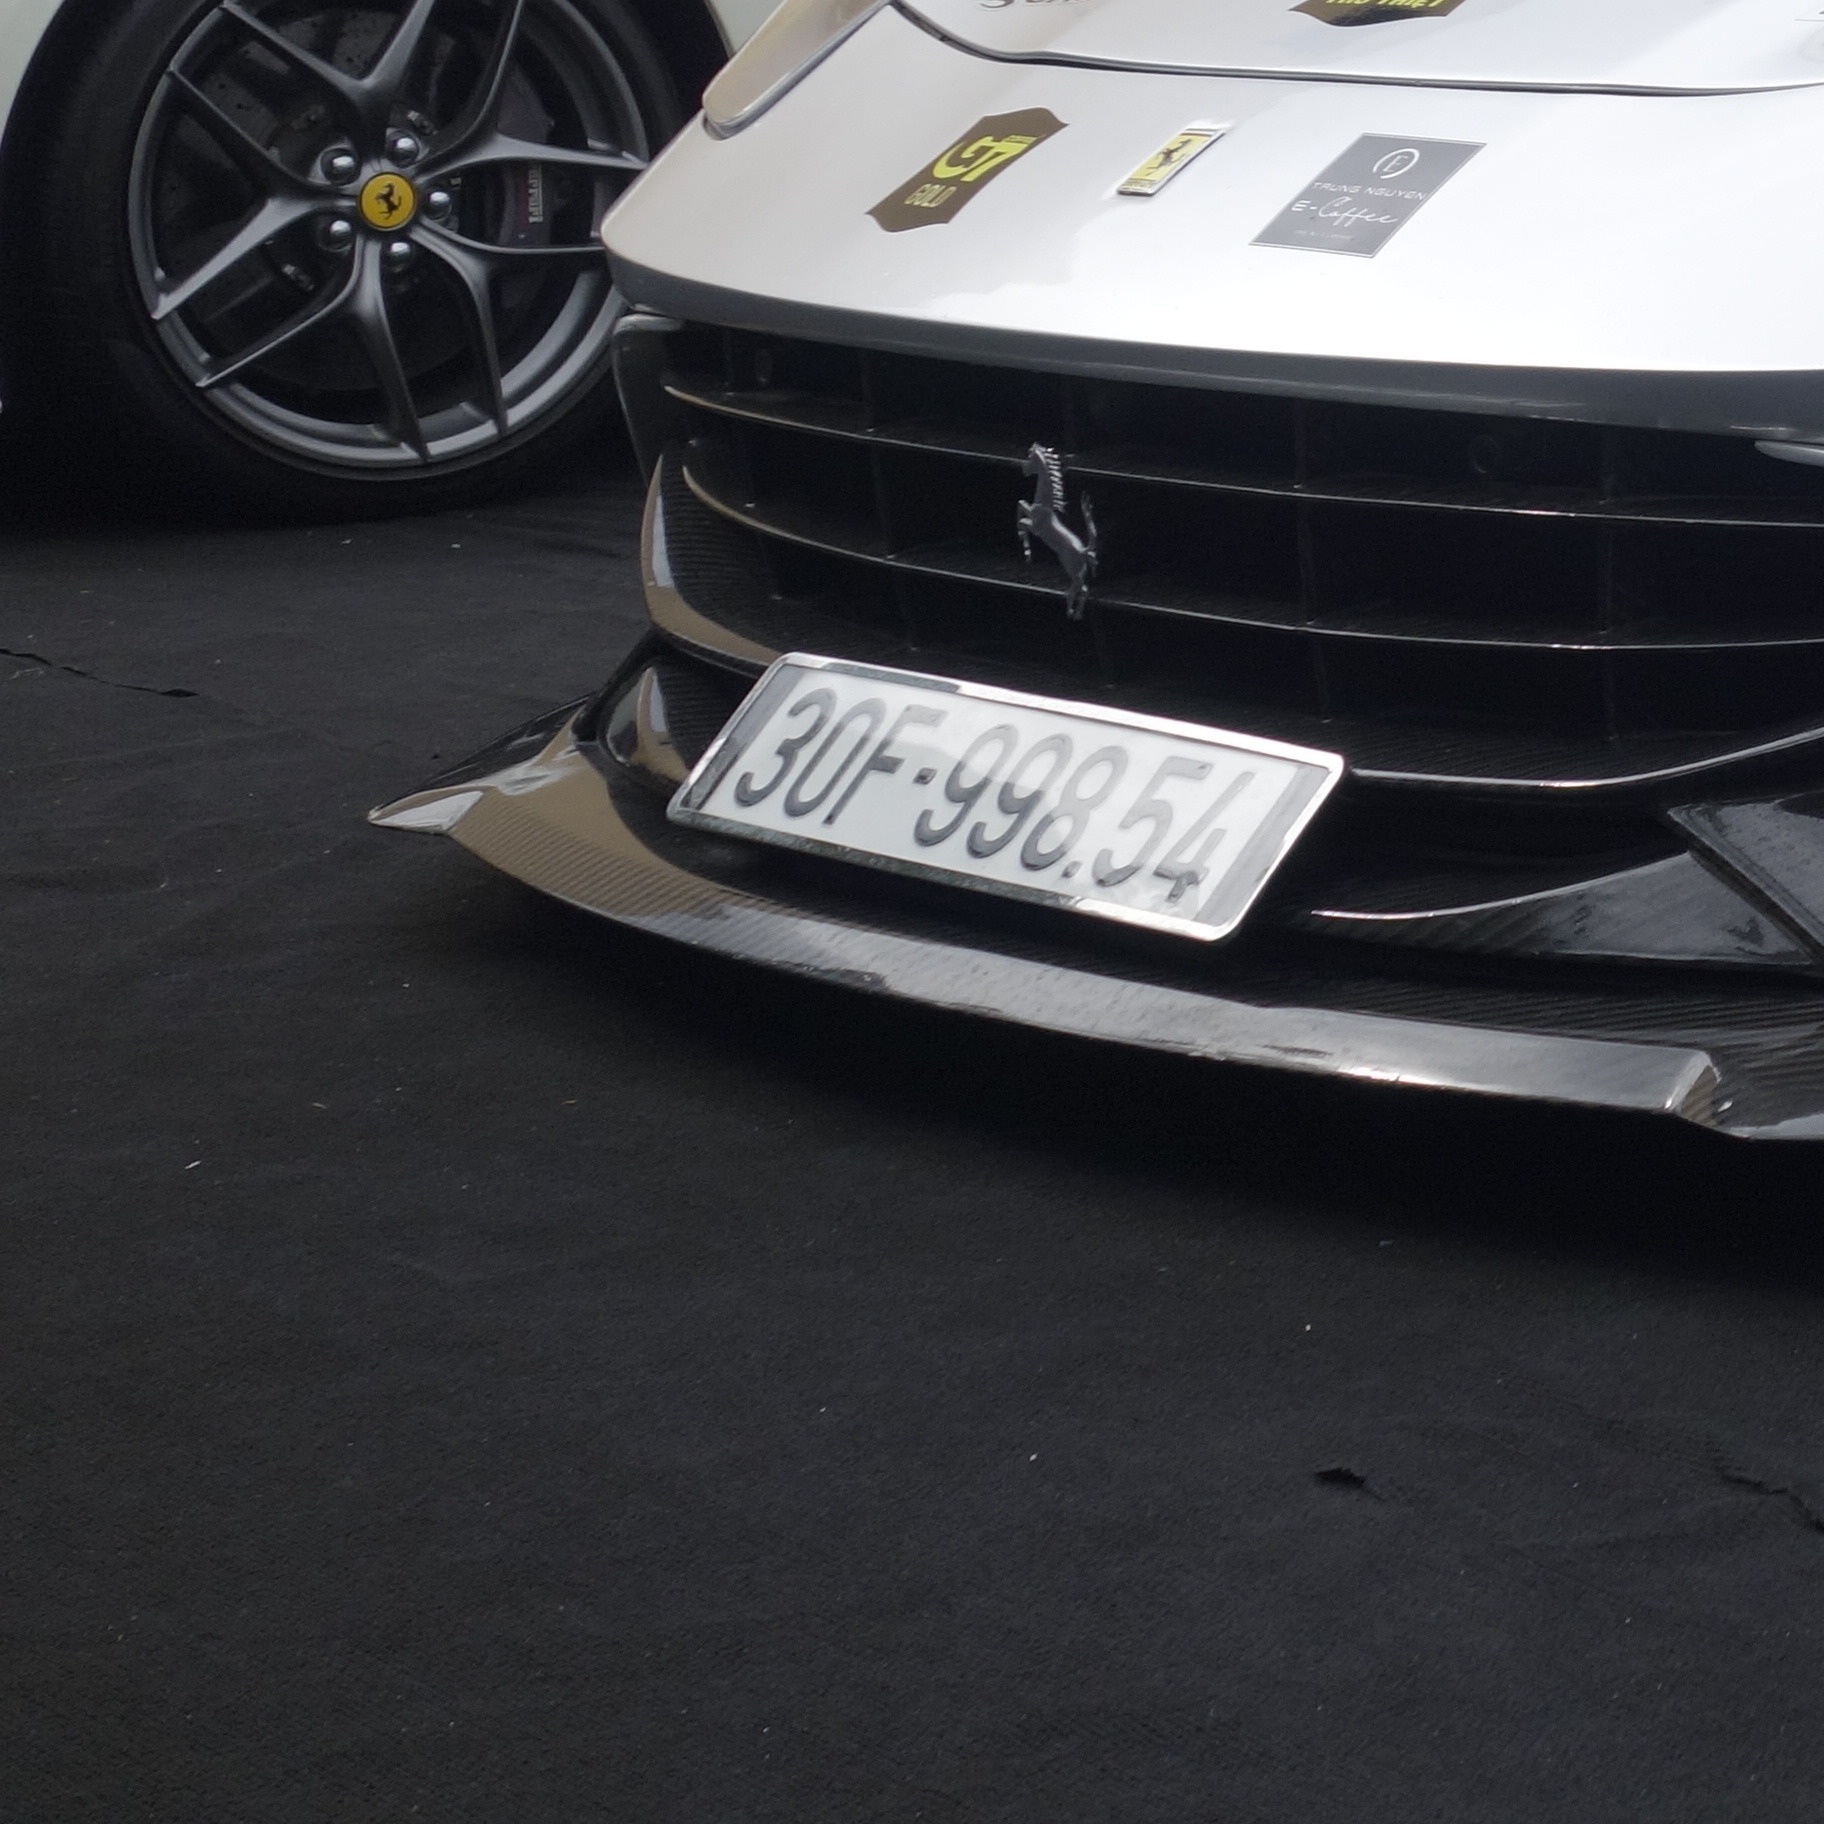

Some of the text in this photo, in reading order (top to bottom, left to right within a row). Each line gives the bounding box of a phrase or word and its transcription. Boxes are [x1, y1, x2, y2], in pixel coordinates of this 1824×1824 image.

[904, 183, 958, 208] GOLD
[1312, 182, 1362, 193] TRUNG
[1291, 196, 1399, 227] E-Coffee
[733, 686, 1256, 904] 30F-998.54
